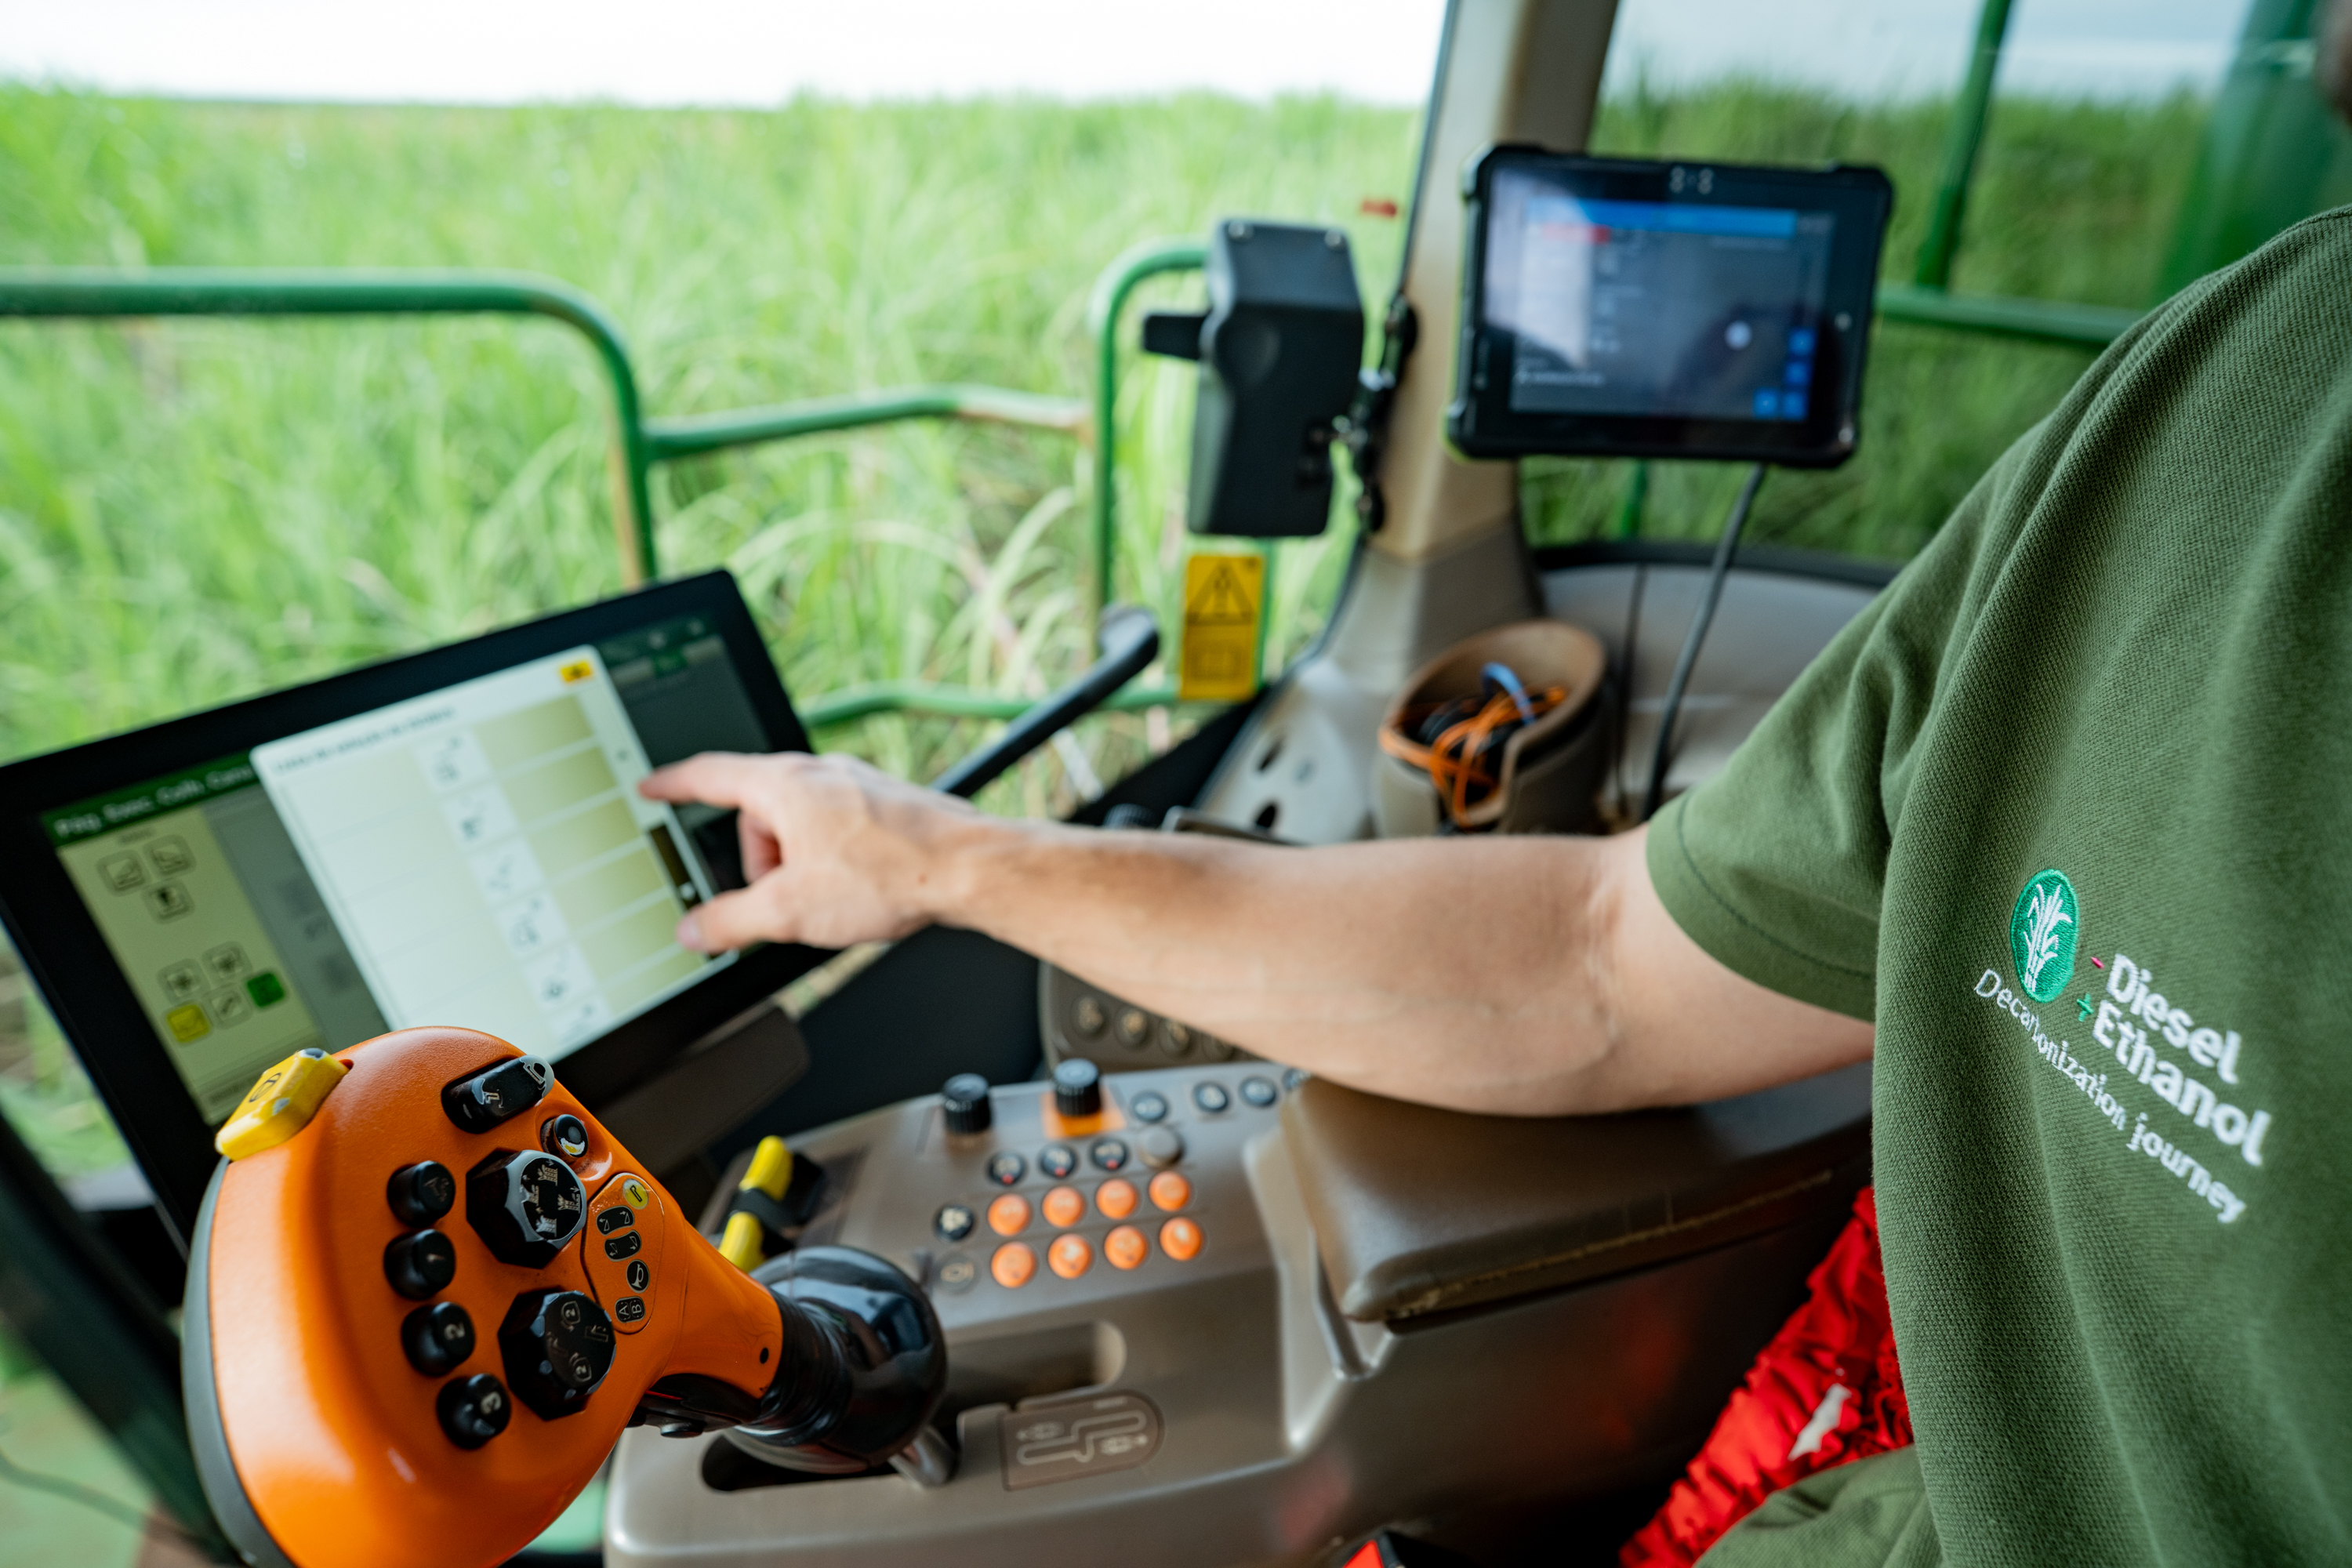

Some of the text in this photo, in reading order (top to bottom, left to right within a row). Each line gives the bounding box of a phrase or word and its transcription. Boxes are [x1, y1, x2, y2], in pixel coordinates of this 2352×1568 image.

[2106, 953, 2241, 1085] Diesel
[2092, 1000, 2270, 1167] Ethanol
[2126, 1112, 2247, 1225] journey
[619, 1305, 630, 1316] A
[631, 1304, 642, 1315] B
[444, 1322, 466, 1340] 2
[480, 1391, 502, 1414] 3
